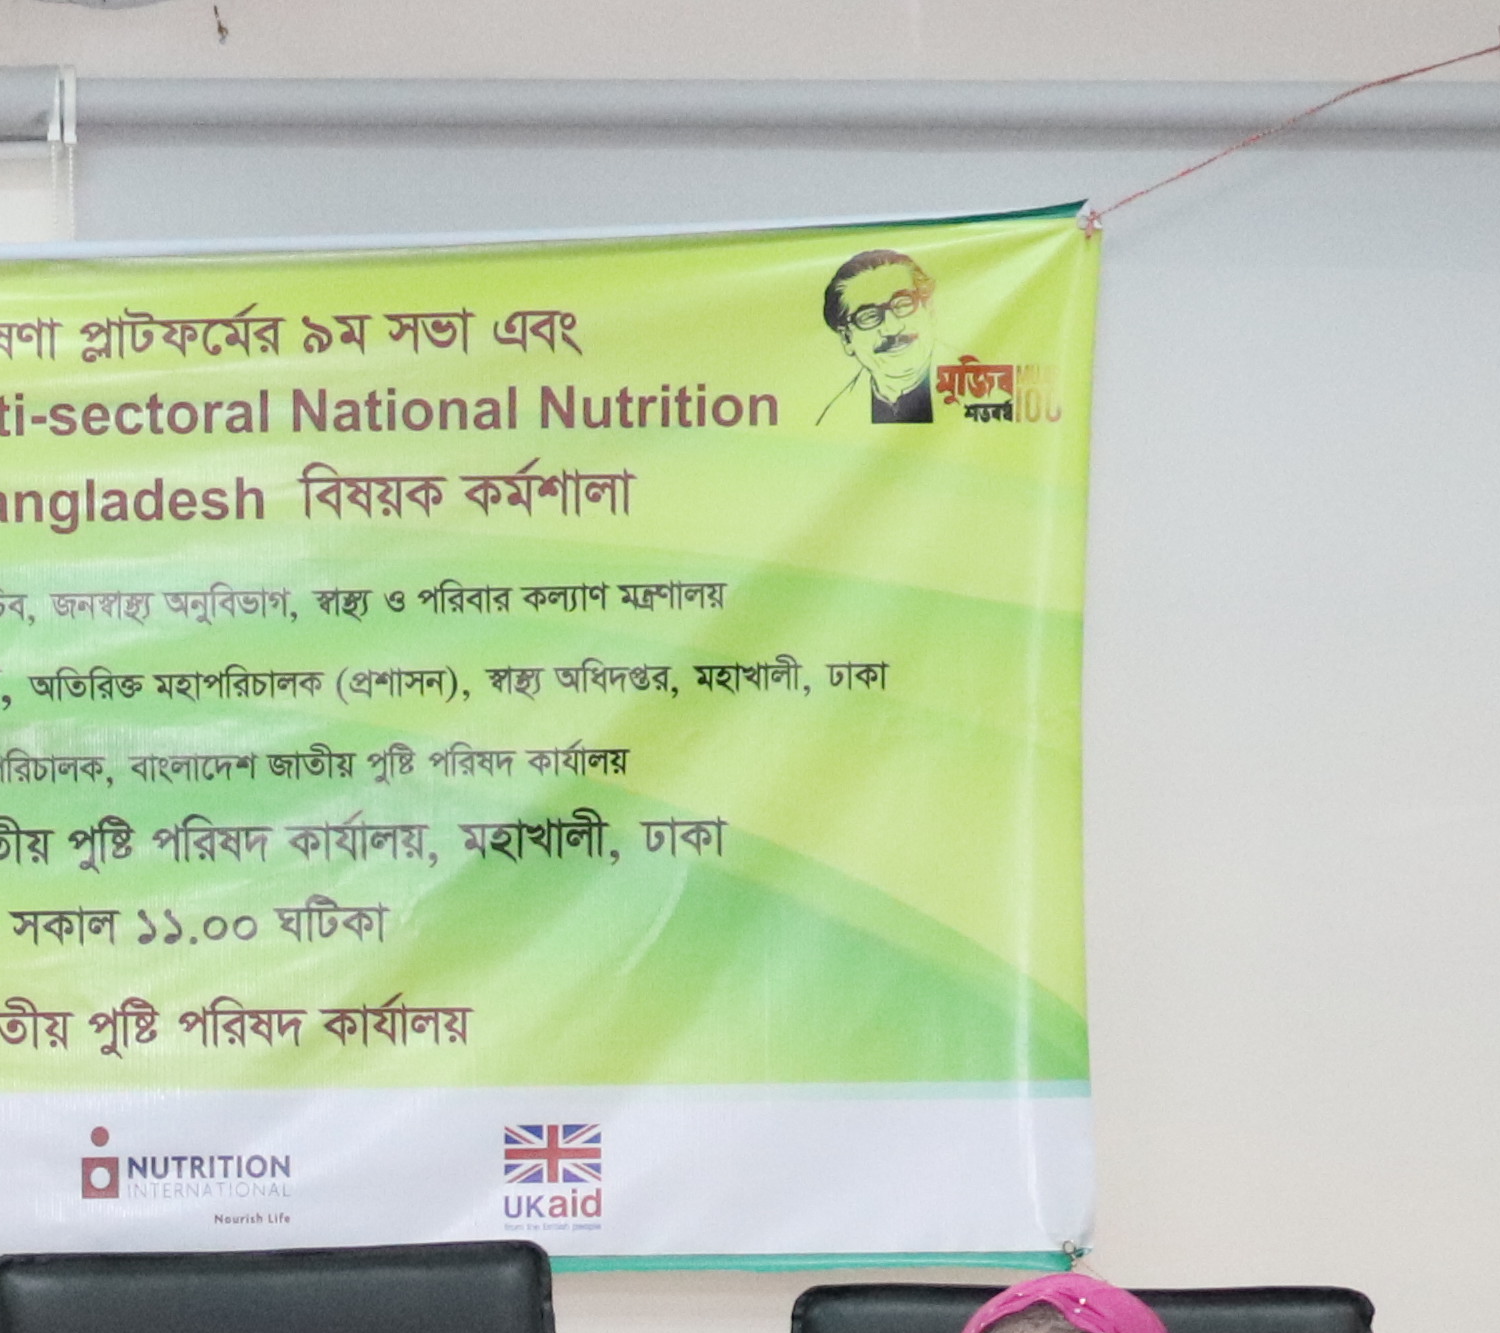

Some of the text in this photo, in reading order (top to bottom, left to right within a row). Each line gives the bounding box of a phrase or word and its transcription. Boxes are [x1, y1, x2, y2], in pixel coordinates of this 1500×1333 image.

[301, 315, 372, 354] ৯ম
[383, 307, 476, 354] সভা
[493, 310, 583, 356] এবং
[292, 386, 517, 433] National
[540, 383, 778, 429] Nutrition
[297, 462, 448, 519] বিষয়ক
[459, 457, 637, 516] কর্মশালা
[162, 581, 298, 626] অনুবিভাগ,
[384, 590, 405, 613] ও
[417, 578, 513, 613] পরিবার
[520, 582, 610, 612] কল্যাণ
[28, 665, 144, 701] অতিরিক্ত
[153, 663, 324, 701] মহাপরিচালক
[693, 654, 810, 695] মহাখালী,
[826, 661, 889, 690] ঢাকা
[129, 753, 259, 783] বাংলাদেশ
[266, 742, 357, 779] জাতীয়
[367, 742, 416, 785] পুষ্টি
[428, 741, 517, 776] পরিষদ
[526, 739, 630, 775] কার্যালয়
[68, 815, 135, 873] পুষ্টি
[152, 813, 273, 862] পরিষদ
[285, 810, 438, 868] কার্যালয়,
[459, 807, 620, 865] মহাখালী,
[640, 816, 728, 856] ঢাকা
[9, 907, 121, 945] সকাল
[274, 894, 390, 942] ঘটিকা
[88, 997, 160, 1059] পুষ্টি
[178, 995, 307, 1047] পরিষদ
[319, 992, 474, 1047] কার্যালয়
[127, 1155, 291, 1179] NUTRITION
[127, 1181, 291, 1199] INTERNATIONAL
[214, 1212, 291, 1224] Nourish Life
